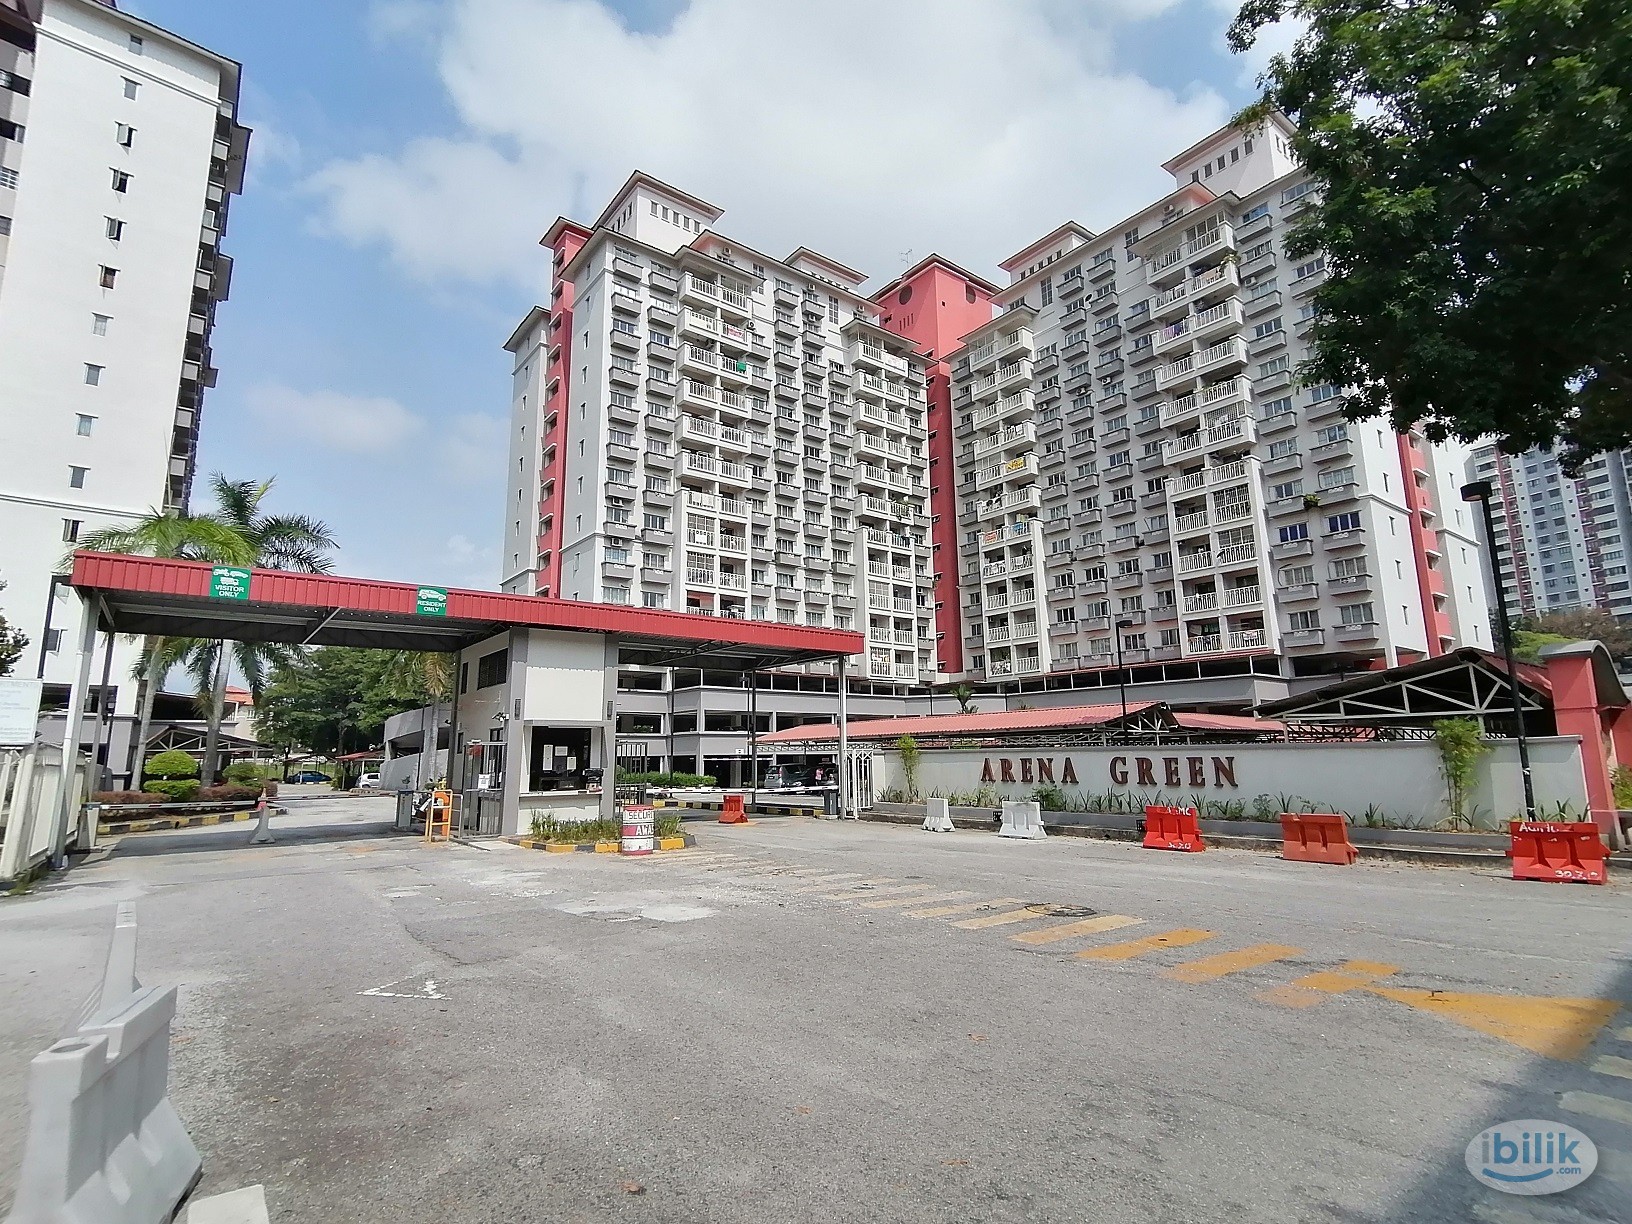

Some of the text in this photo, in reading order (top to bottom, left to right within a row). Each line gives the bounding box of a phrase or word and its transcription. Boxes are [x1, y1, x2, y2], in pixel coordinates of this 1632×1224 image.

[214, 584, 244, 593] VISITOR
[218, 590, 240, 598] ONLY
[417, 599, 447, 608] RESIDENT
[980, 756, 1239, 788] ARENA GREEN
